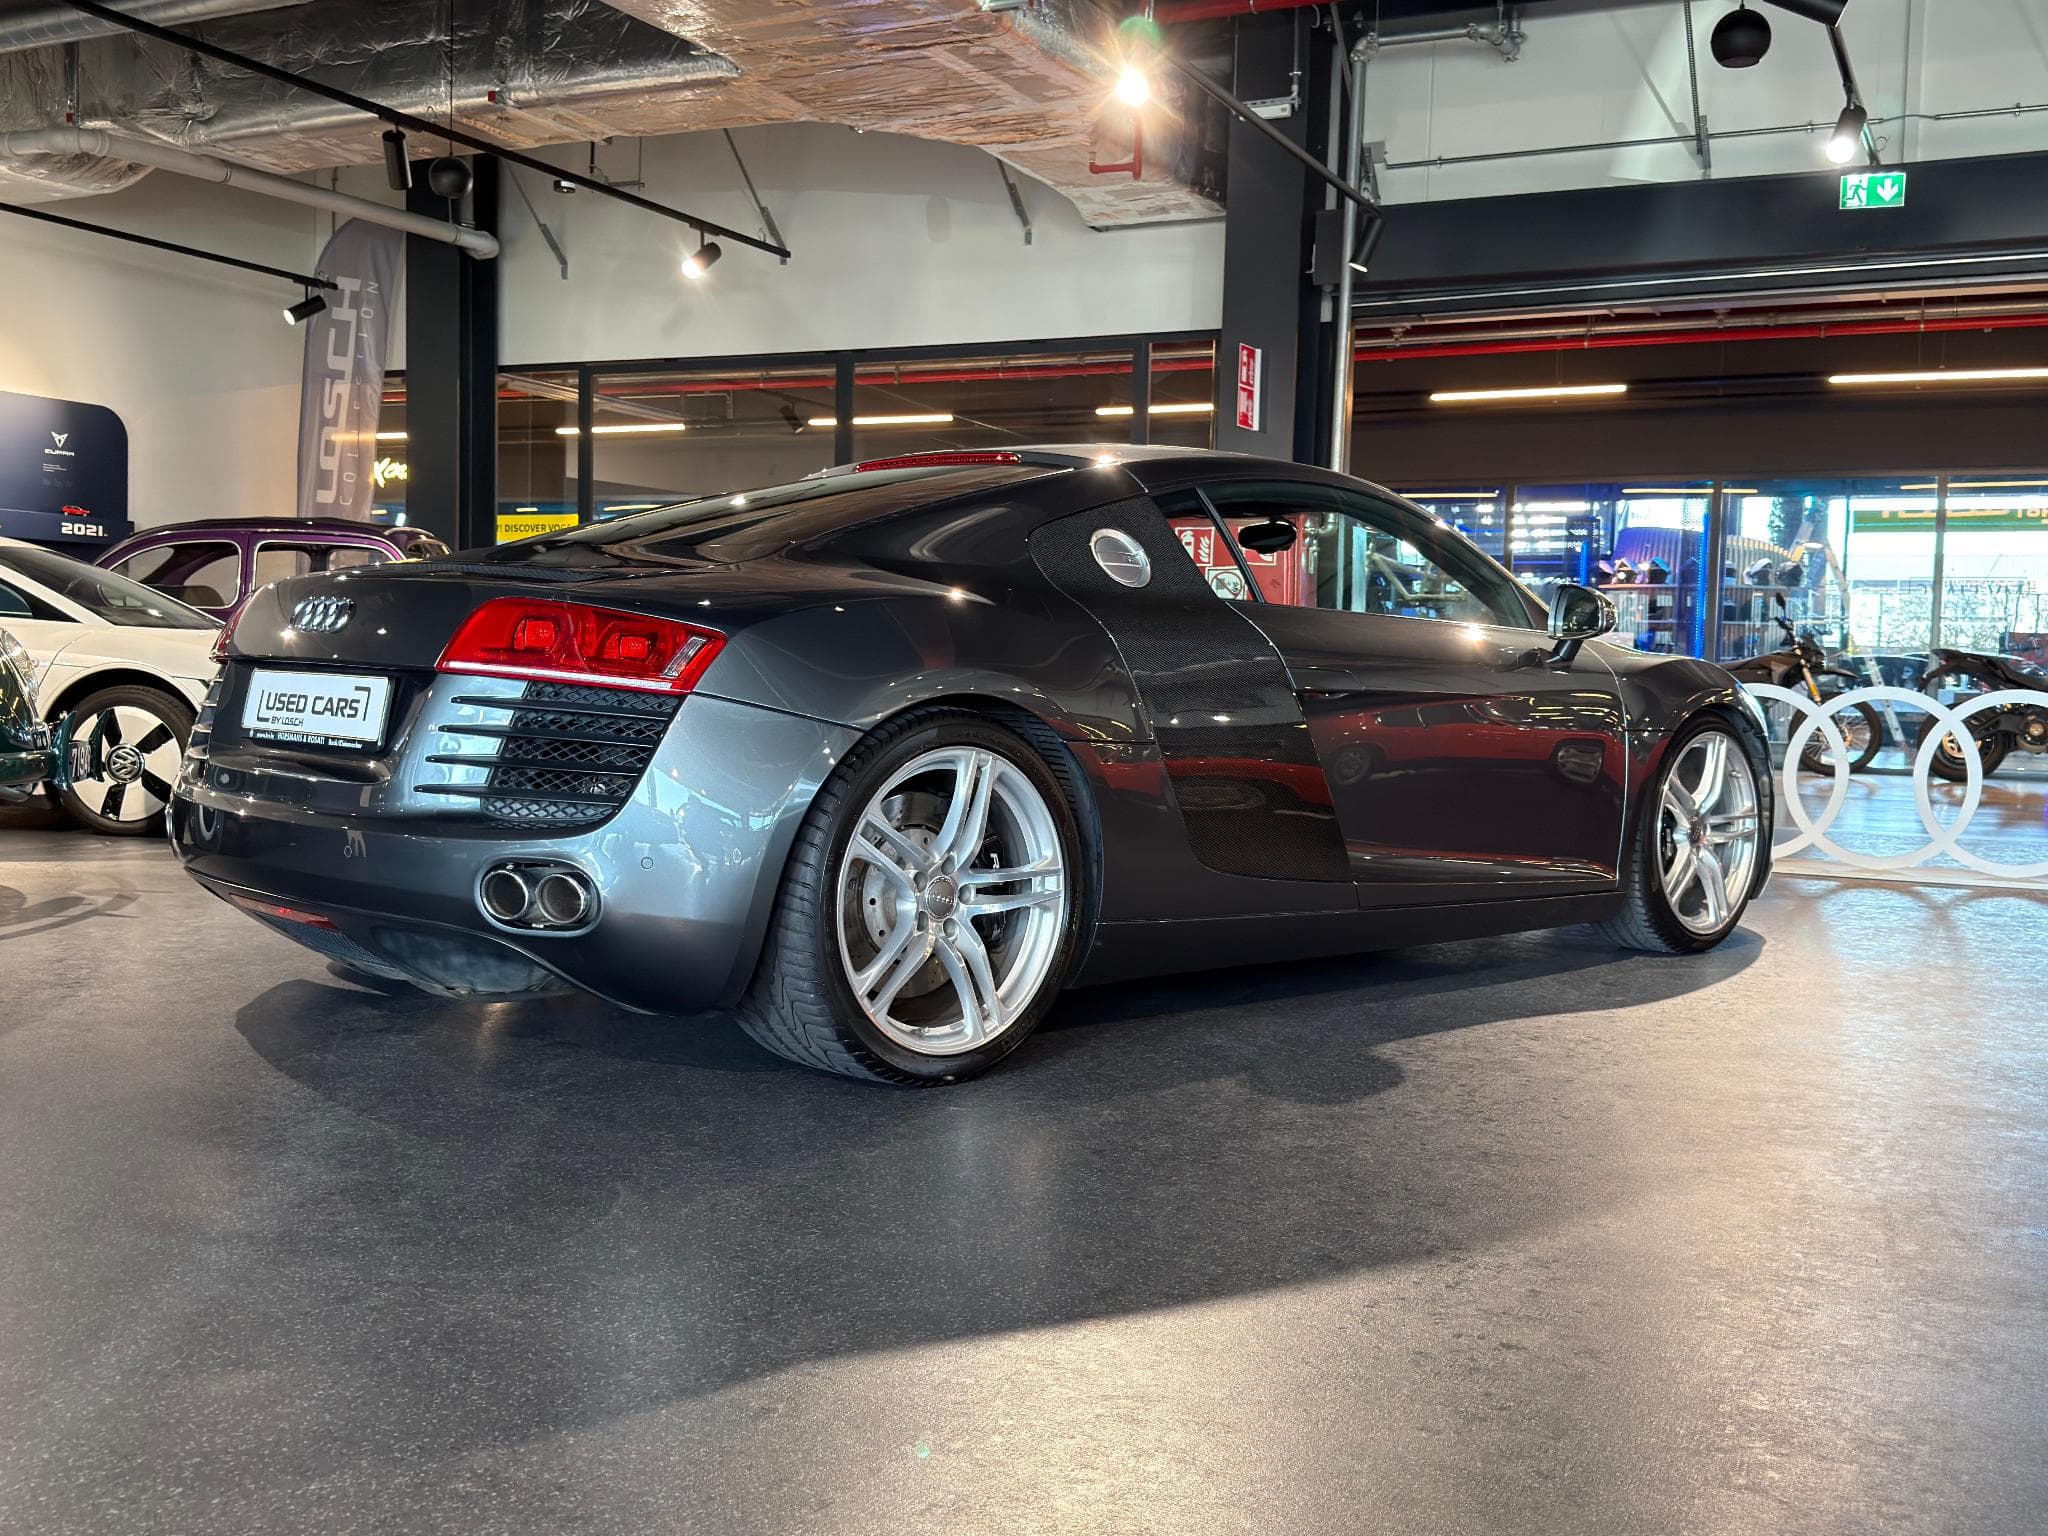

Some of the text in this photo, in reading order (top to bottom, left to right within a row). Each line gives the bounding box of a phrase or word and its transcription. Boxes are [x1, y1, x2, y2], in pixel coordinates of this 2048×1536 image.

[316, 276, 362, 504] LOSCH
[504, 524, 546, 533] DISCOVER
[265, 692, 361, 719] USED CARS
[271, 716, 304, 727] BY LOSCH
